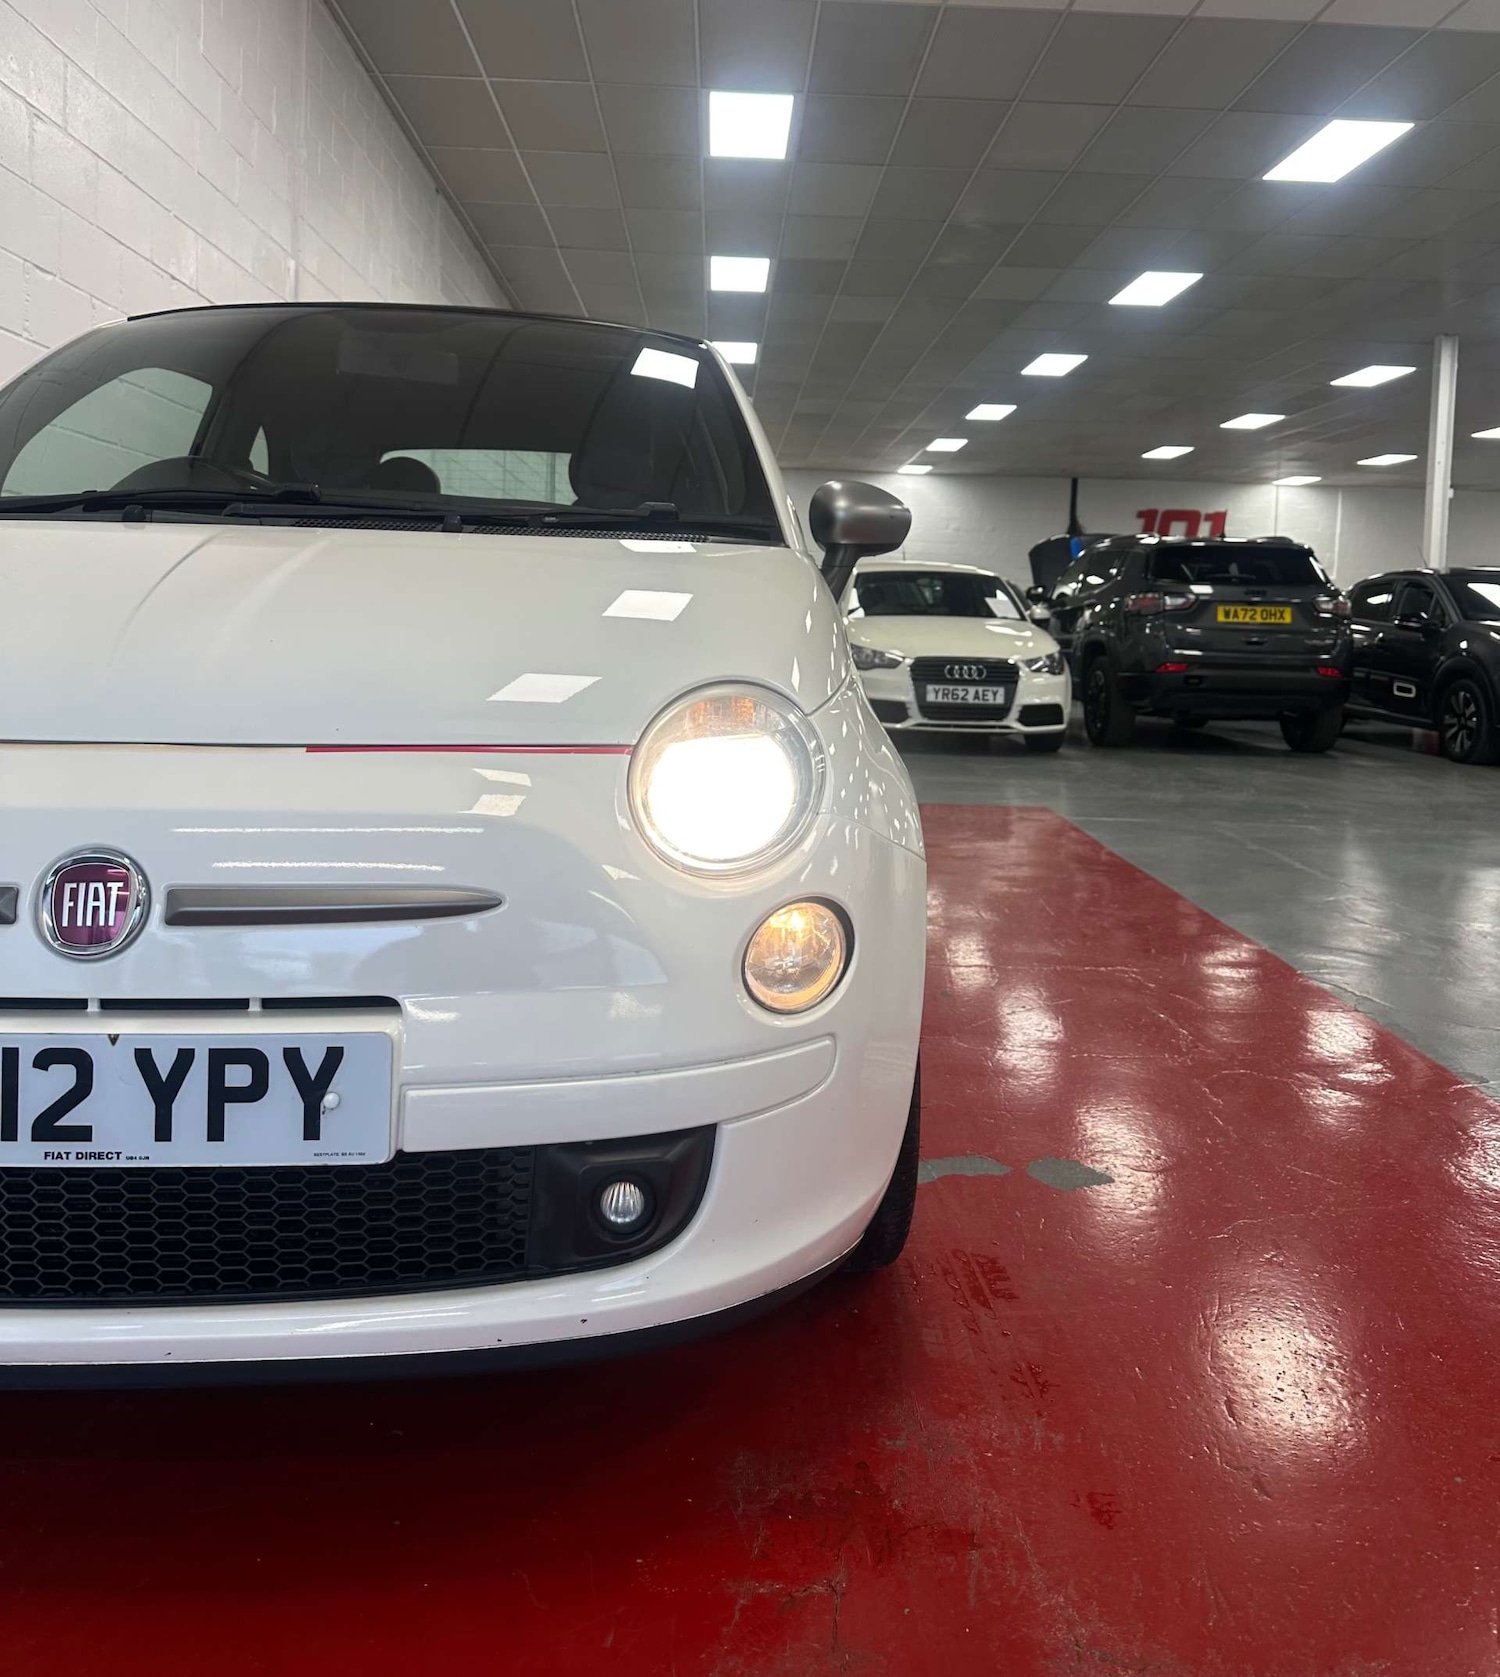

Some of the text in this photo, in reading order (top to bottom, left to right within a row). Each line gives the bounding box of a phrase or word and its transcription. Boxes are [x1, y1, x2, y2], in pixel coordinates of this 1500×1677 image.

[1223, 607, 1286, 621] WA72 OHX
[933, 687, 999, 702] YR62 AEY
[62, 882, 124, 927] FIAT
[134, 1046, 345, 1142] YPY
[44, 1151, 72, 1160] FIAT
[75, 1151, 122, 1160] DIRECT
